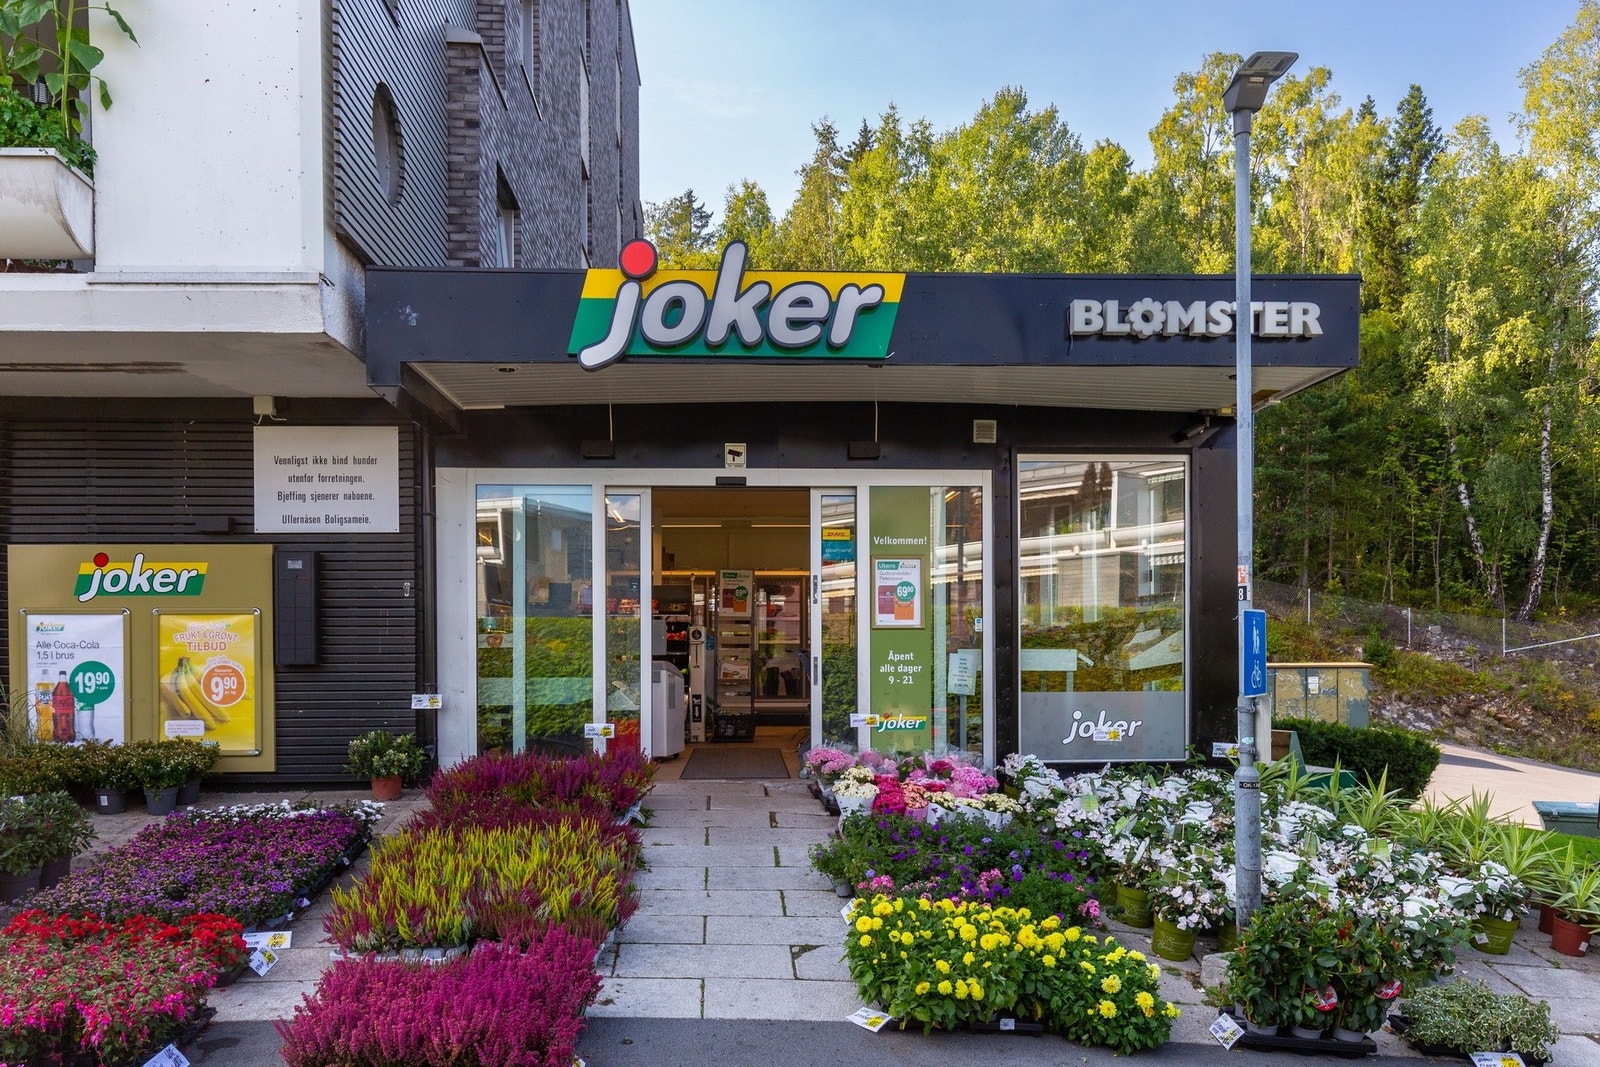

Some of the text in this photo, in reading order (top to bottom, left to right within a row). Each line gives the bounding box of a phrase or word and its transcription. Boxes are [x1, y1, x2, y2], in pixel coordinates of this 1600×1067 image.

[577, 238, 885, 372] joker
[1070, 298, 1323, 338] BLOMSTER
[274, 455, 378, 467] Vennligst ikke bind hunder
[288, 473, 365, 485] utenfor forretningen.
[277, 491, 375, 502] Bjeffing sjenerer naboene.
[325, 514, 371, 526] Boligsameie.
[873, 536, 927, 545] Velkommen!
[78, 552, 199, 603] joker
[174, 631, 201, 642] FRUKT
[36, 641, 100, 649] Alle Coca-Cola
[37, 651, 49, 661] 1,5
[55, 651, 75, 660] brus
[888, 650, 914, 662] Åpent
[880, 664, 922, 674] alle dager
[888, 676, 894, 684] 9
[902, 676, 914, 684] 21
[878, 712, 923, 733] joker
[1062, 710, 1142, 744] joker
